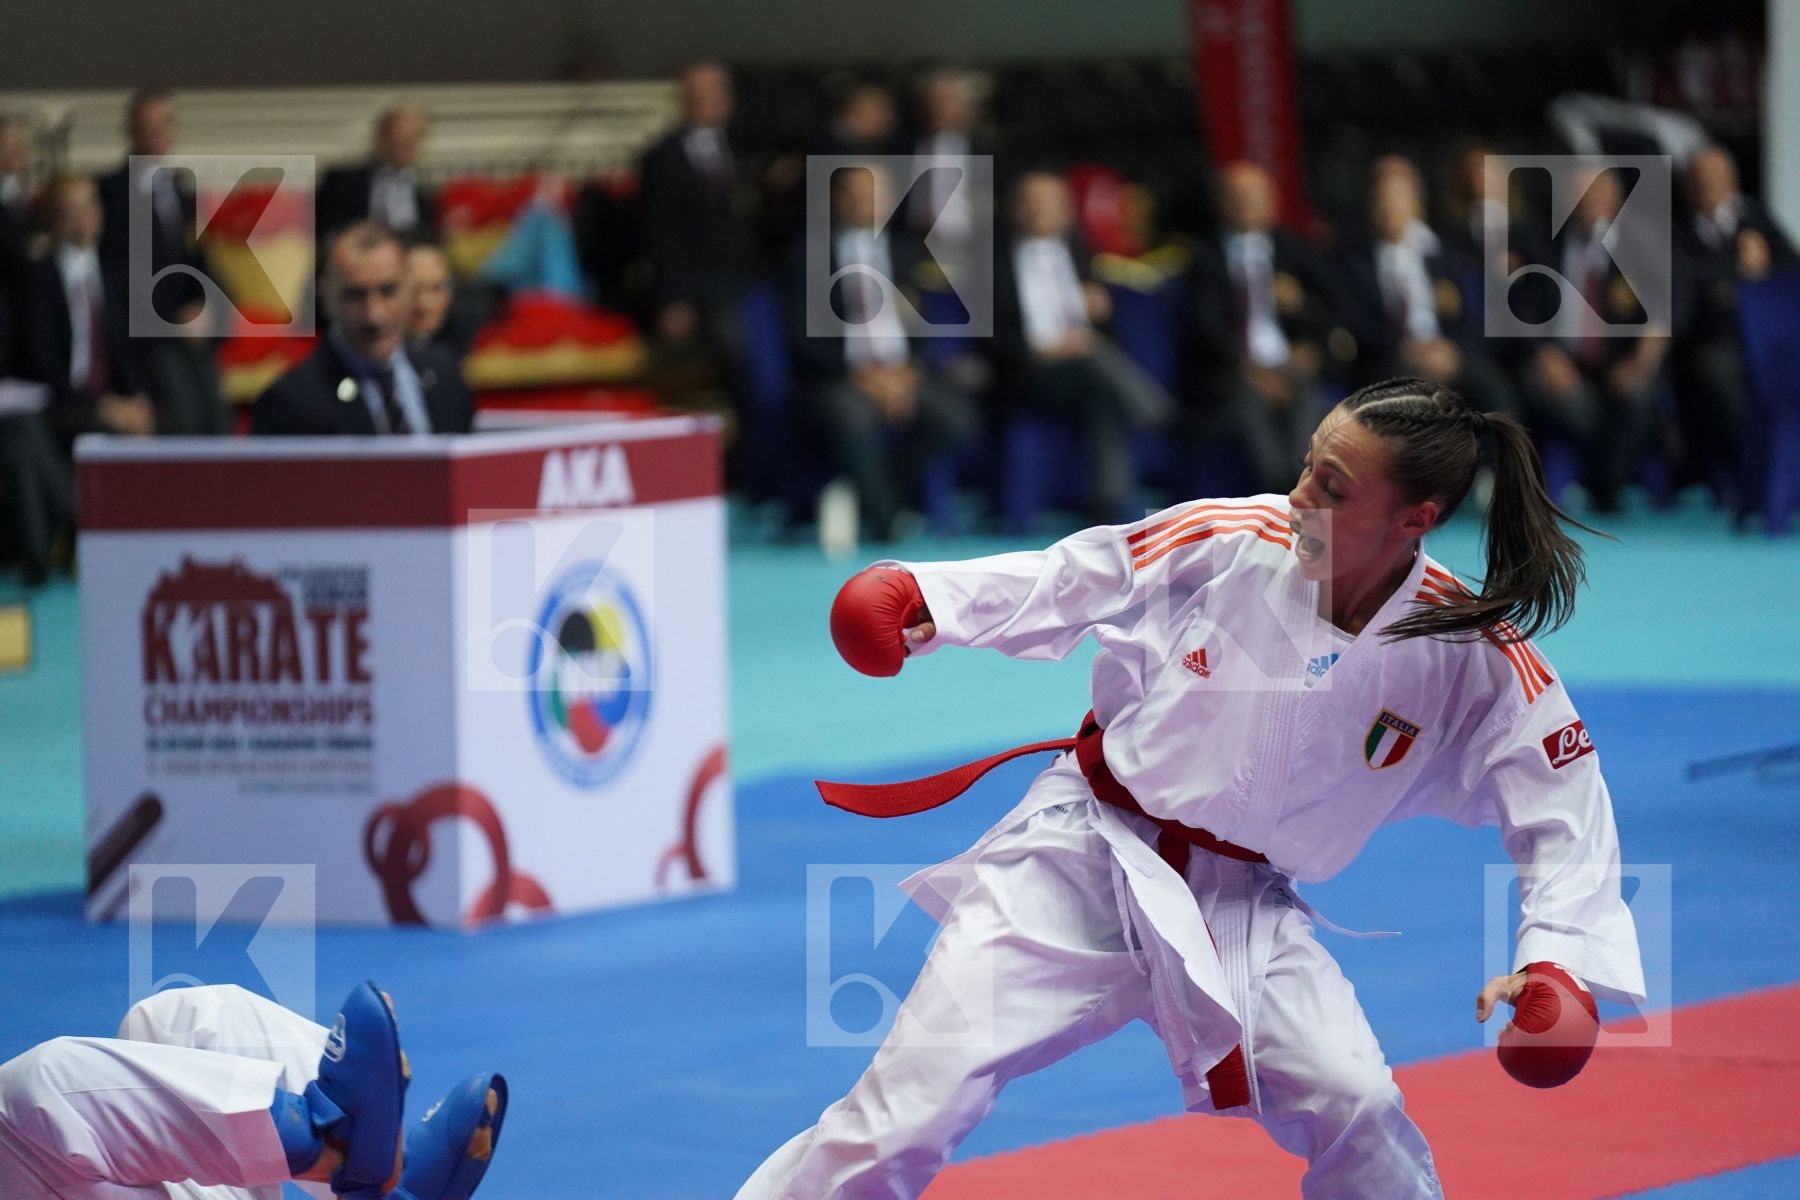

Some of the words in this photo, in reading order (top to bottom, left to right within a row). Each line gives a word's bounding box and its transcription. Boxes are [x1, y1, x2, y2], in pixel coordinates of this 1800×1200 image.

[535, 445, 636, 512] AKA
[142, 601, 371, 684] KARATE
[1182, 658, 1211, 678] adidas
[1382, 714, 1415, 735] ITALIA
